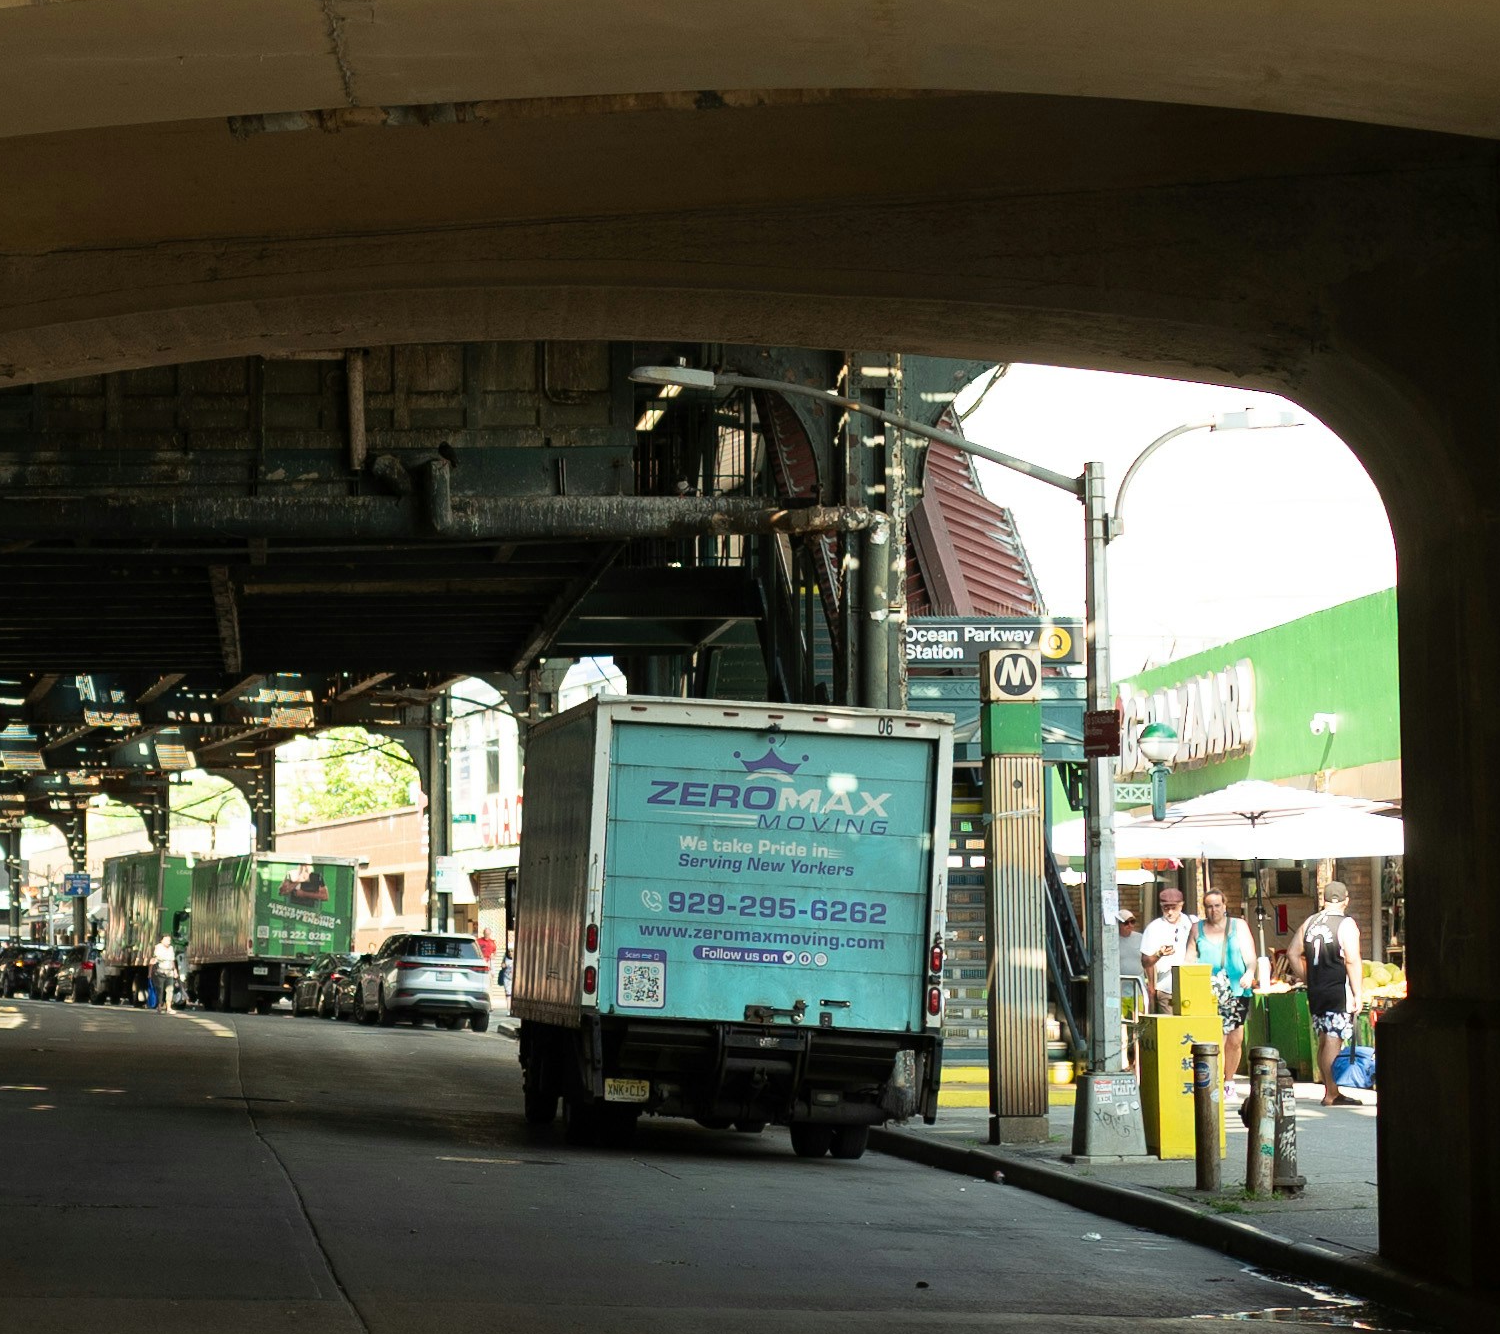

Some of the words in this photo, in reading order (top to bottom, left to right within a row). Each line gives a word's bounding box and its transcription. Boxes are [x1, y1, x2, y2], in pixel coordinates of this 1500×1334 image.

[906, 626, 958, 643] Ocean
[964, 626, 1034, 644] Parkway
[906, 644, 964, 660] Station
[999, 657, 1033, 686] M
[878, 717, 893, 735] 06
[647, 780, 892, 817] ZEROMAX
[757, 814, 889, 835] MOVING
[679, 835, 708, 850] We
[712, 838, 753, 854] take
[758, 840, 807, 857] Pride
[812, 842, 828, 858] in
[678, 853, 742, 873] Serving
[747, 857, 785, 872] New
[791, 859, 855, 877] Yorkers
[267, 902, 296, 912] ALWAYS
[668, 891, 887, 925] 929-295-6262
[271, 908, 302, 921] HAPPY
[302, 914, 335, 929] ENDING
[271, 930, 288, 938] 718
[289, 931, 307, 939] 222
[639, 925, 885, 950] www.zeromaxmoving.com
[624, 951, 640, 959] Scan
[702, 947, 740, 961] Follow
[744, 951, 760, 962] us
[763, 951, 778, 963] on
